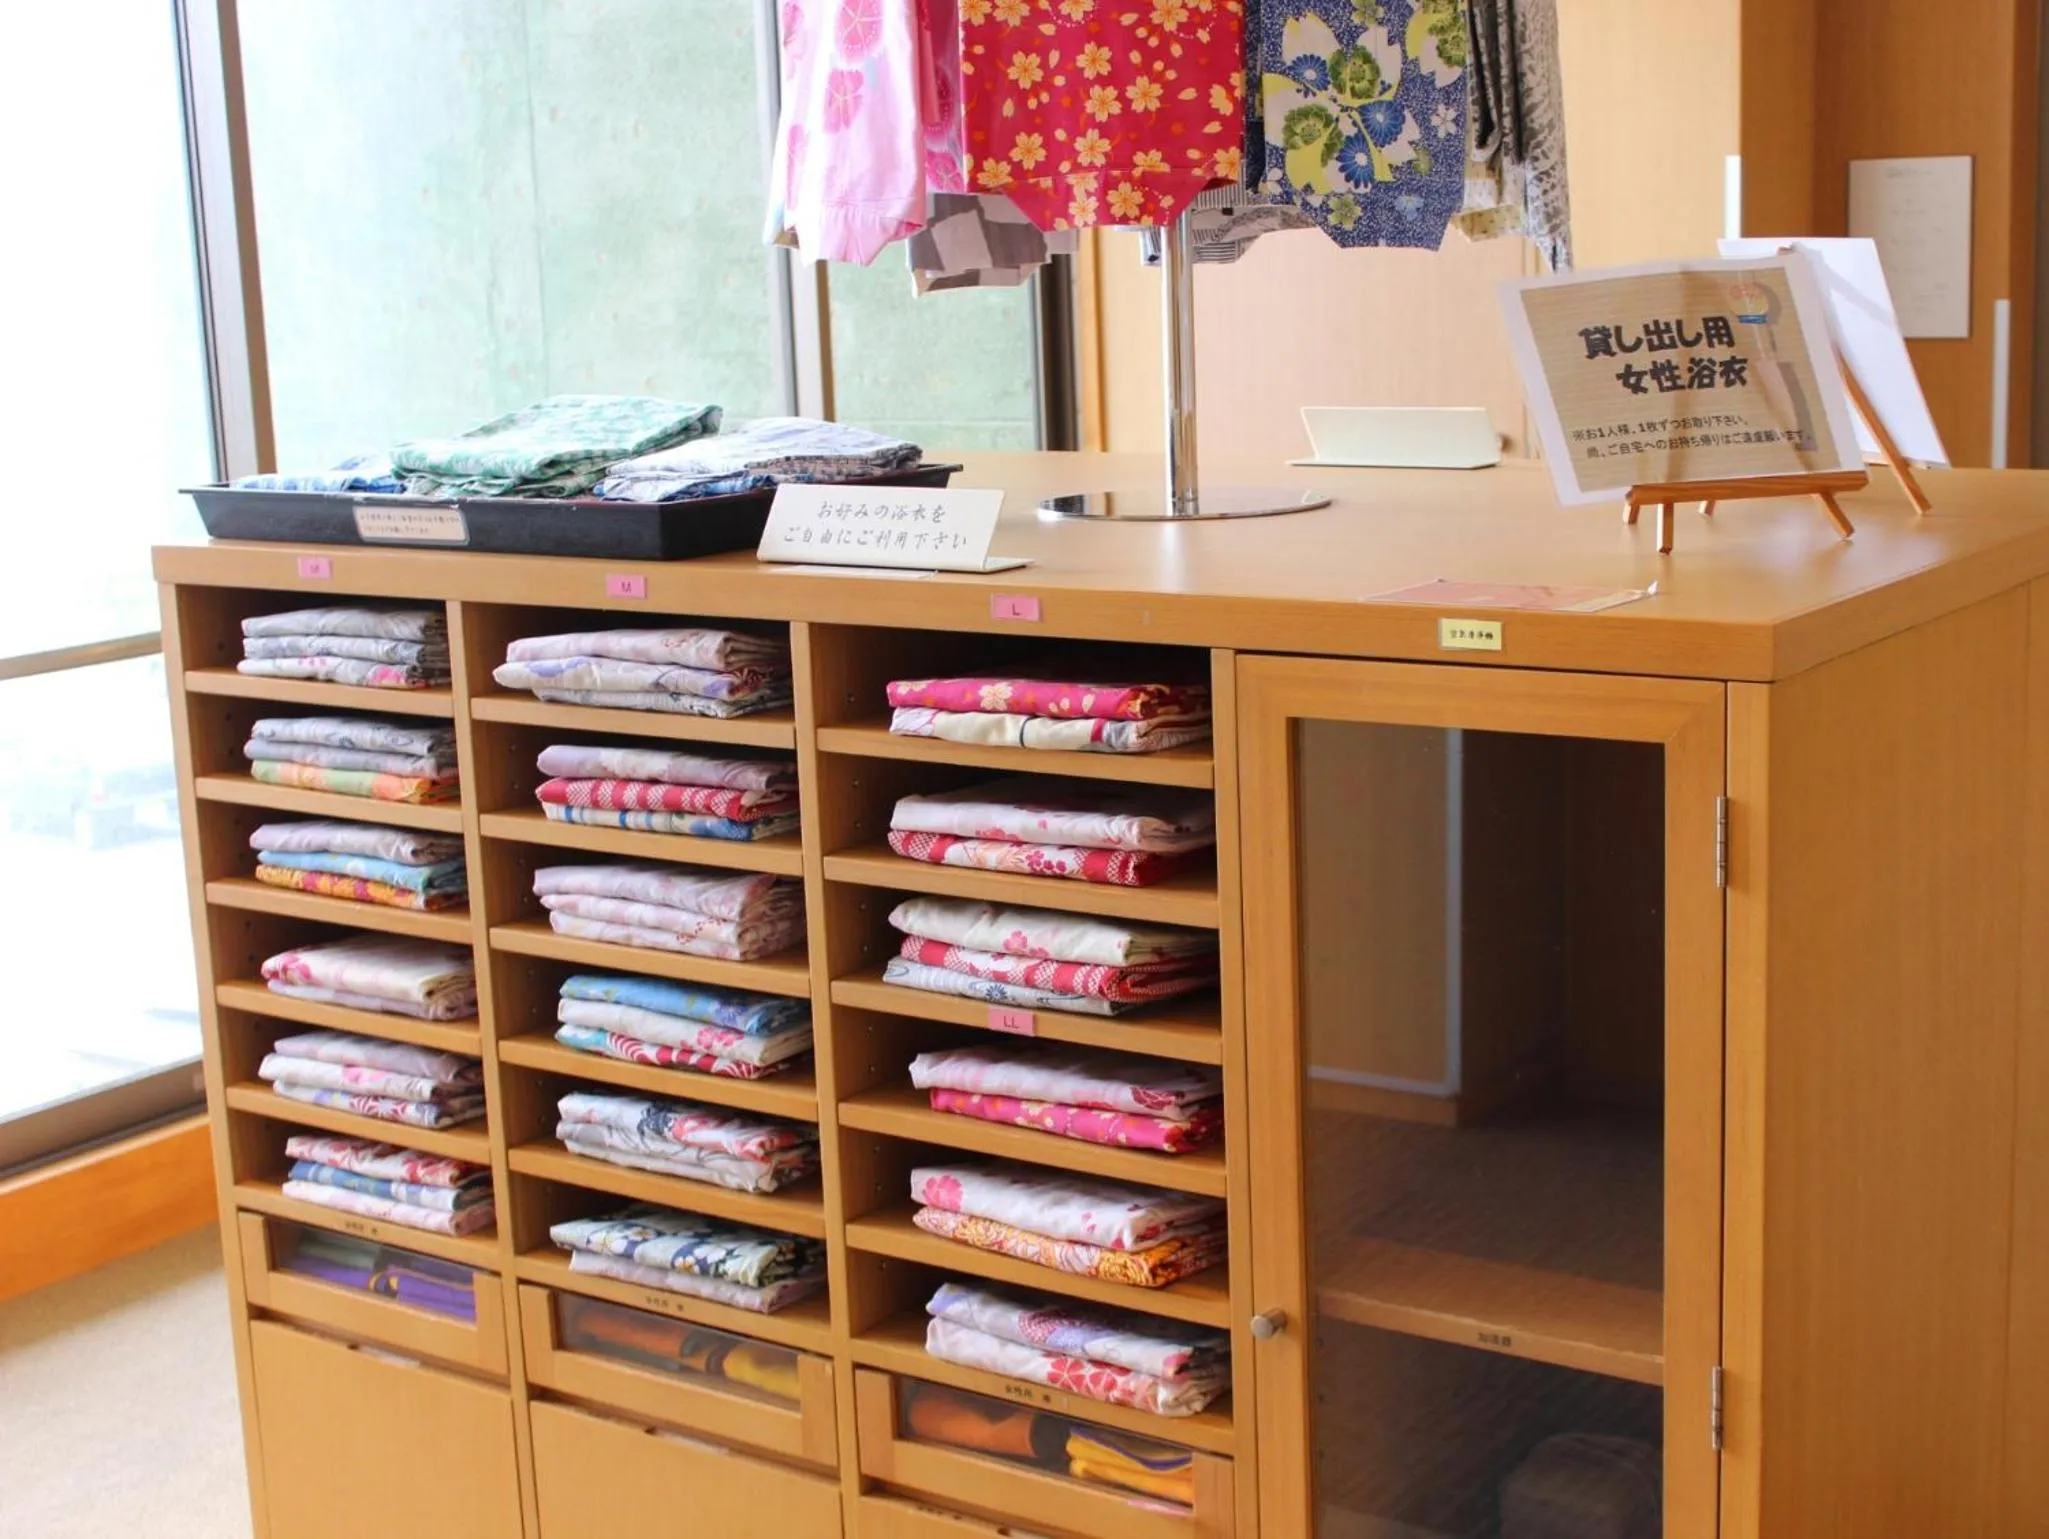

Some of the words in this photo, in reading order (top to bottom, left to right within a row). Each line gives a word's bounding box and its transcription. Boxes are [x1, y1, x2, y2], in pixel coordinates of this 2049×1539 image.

[1578, 315, 1736, 360] 貸し出し用
[1615, 355, 1749, 395] 女性浴衣
[816, 500, 947, 524] お好みの浴衣を
[784, 526, 968, 550] ご自由にご利用下さい
[621, 581, 633, 594] M
[1012, 603, 1022, 617] L
[1003, 1015, 1020, 1029] LL
